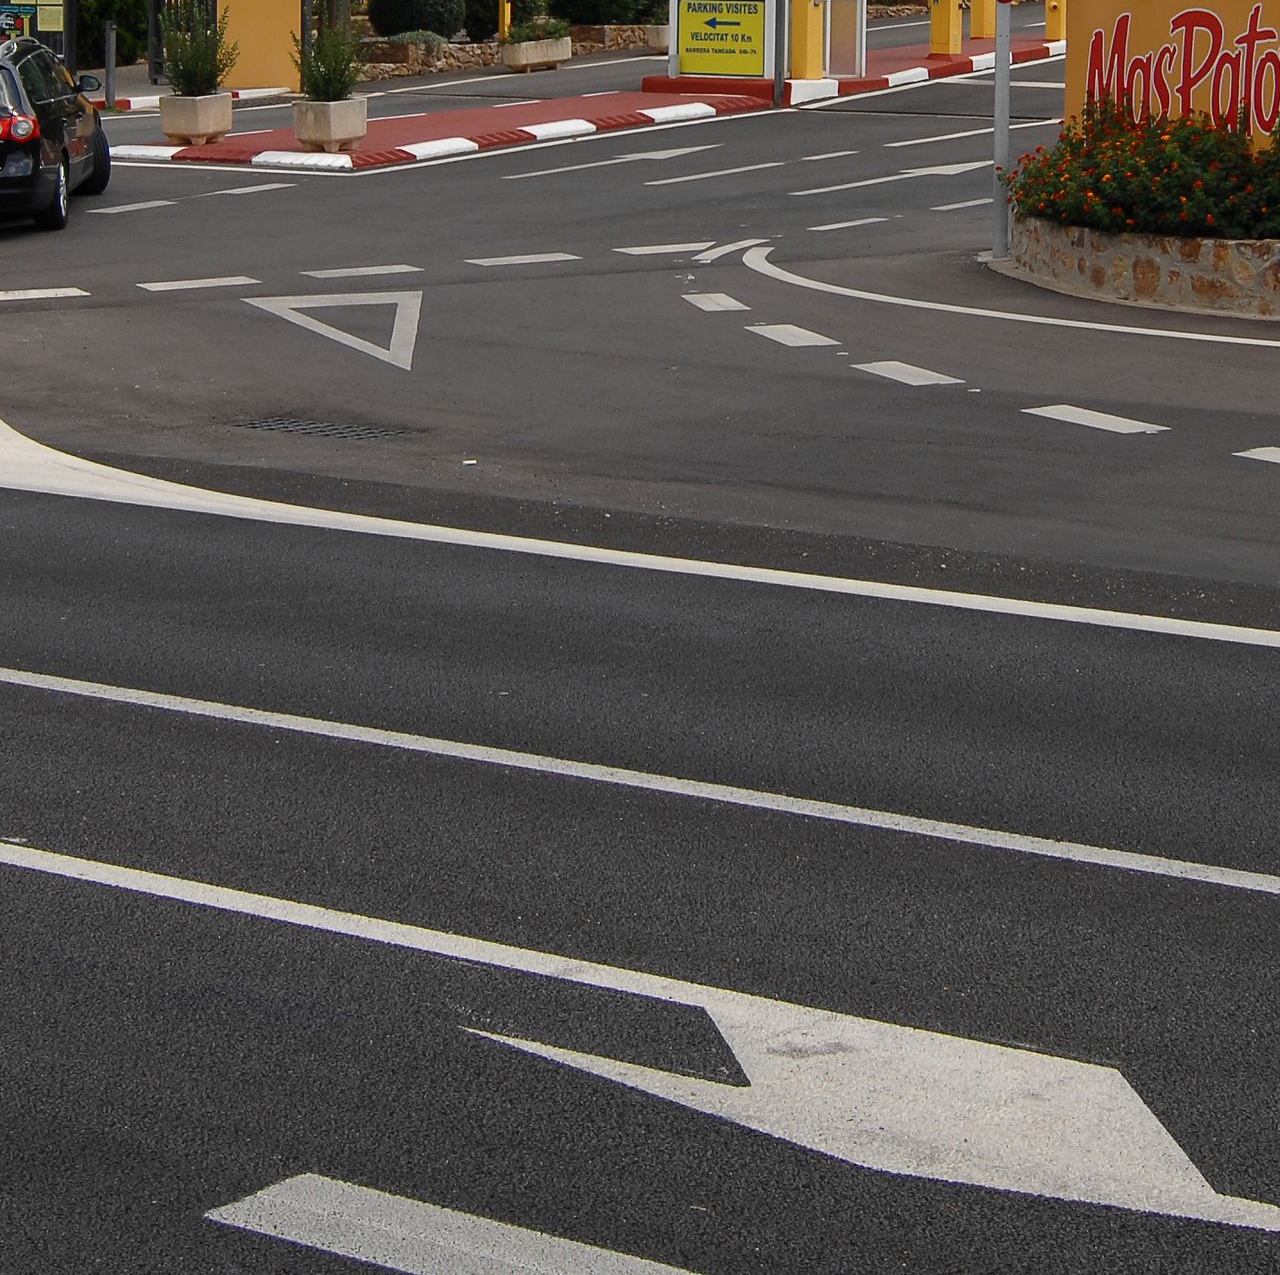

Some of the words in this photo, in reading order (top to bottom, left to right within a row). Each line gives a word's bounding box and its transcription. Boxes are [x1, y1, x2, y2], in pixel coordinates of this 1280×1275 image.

[687, 2, 724, 13] PARKING
[725, 3, 759, 14] VISITES
[691, 32, 729, 41] VELOCITAT
